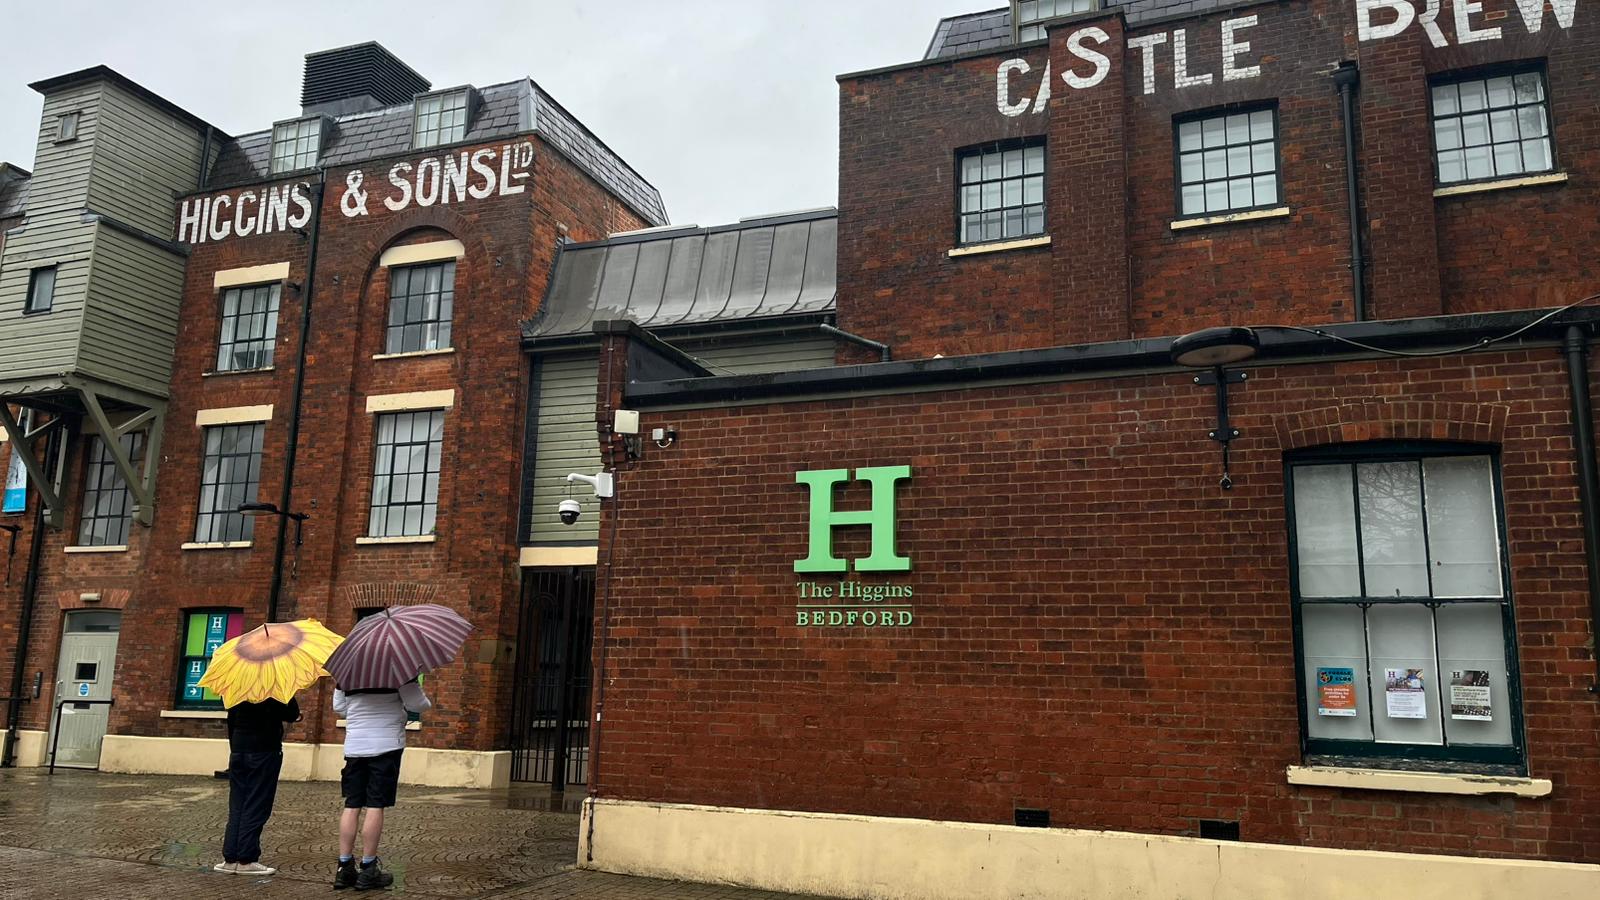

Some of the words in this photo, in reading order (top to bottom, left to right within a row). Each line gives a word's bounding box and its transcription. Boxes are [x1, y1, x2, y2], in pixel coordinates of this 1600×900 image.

[178, 181, 313, 244] HIGGINS
[340, 169, 369, 218] &
[383, 148, 497, 211] SONS
[793, 464, 912, 573] H
[796, 581, 833, 598] The
[838, 581, 914, 601] Higgins
[212, 617, 223, 628] H
[796, 611, 914, 626] BEDFORD
[191, 661, 202, 672] H
